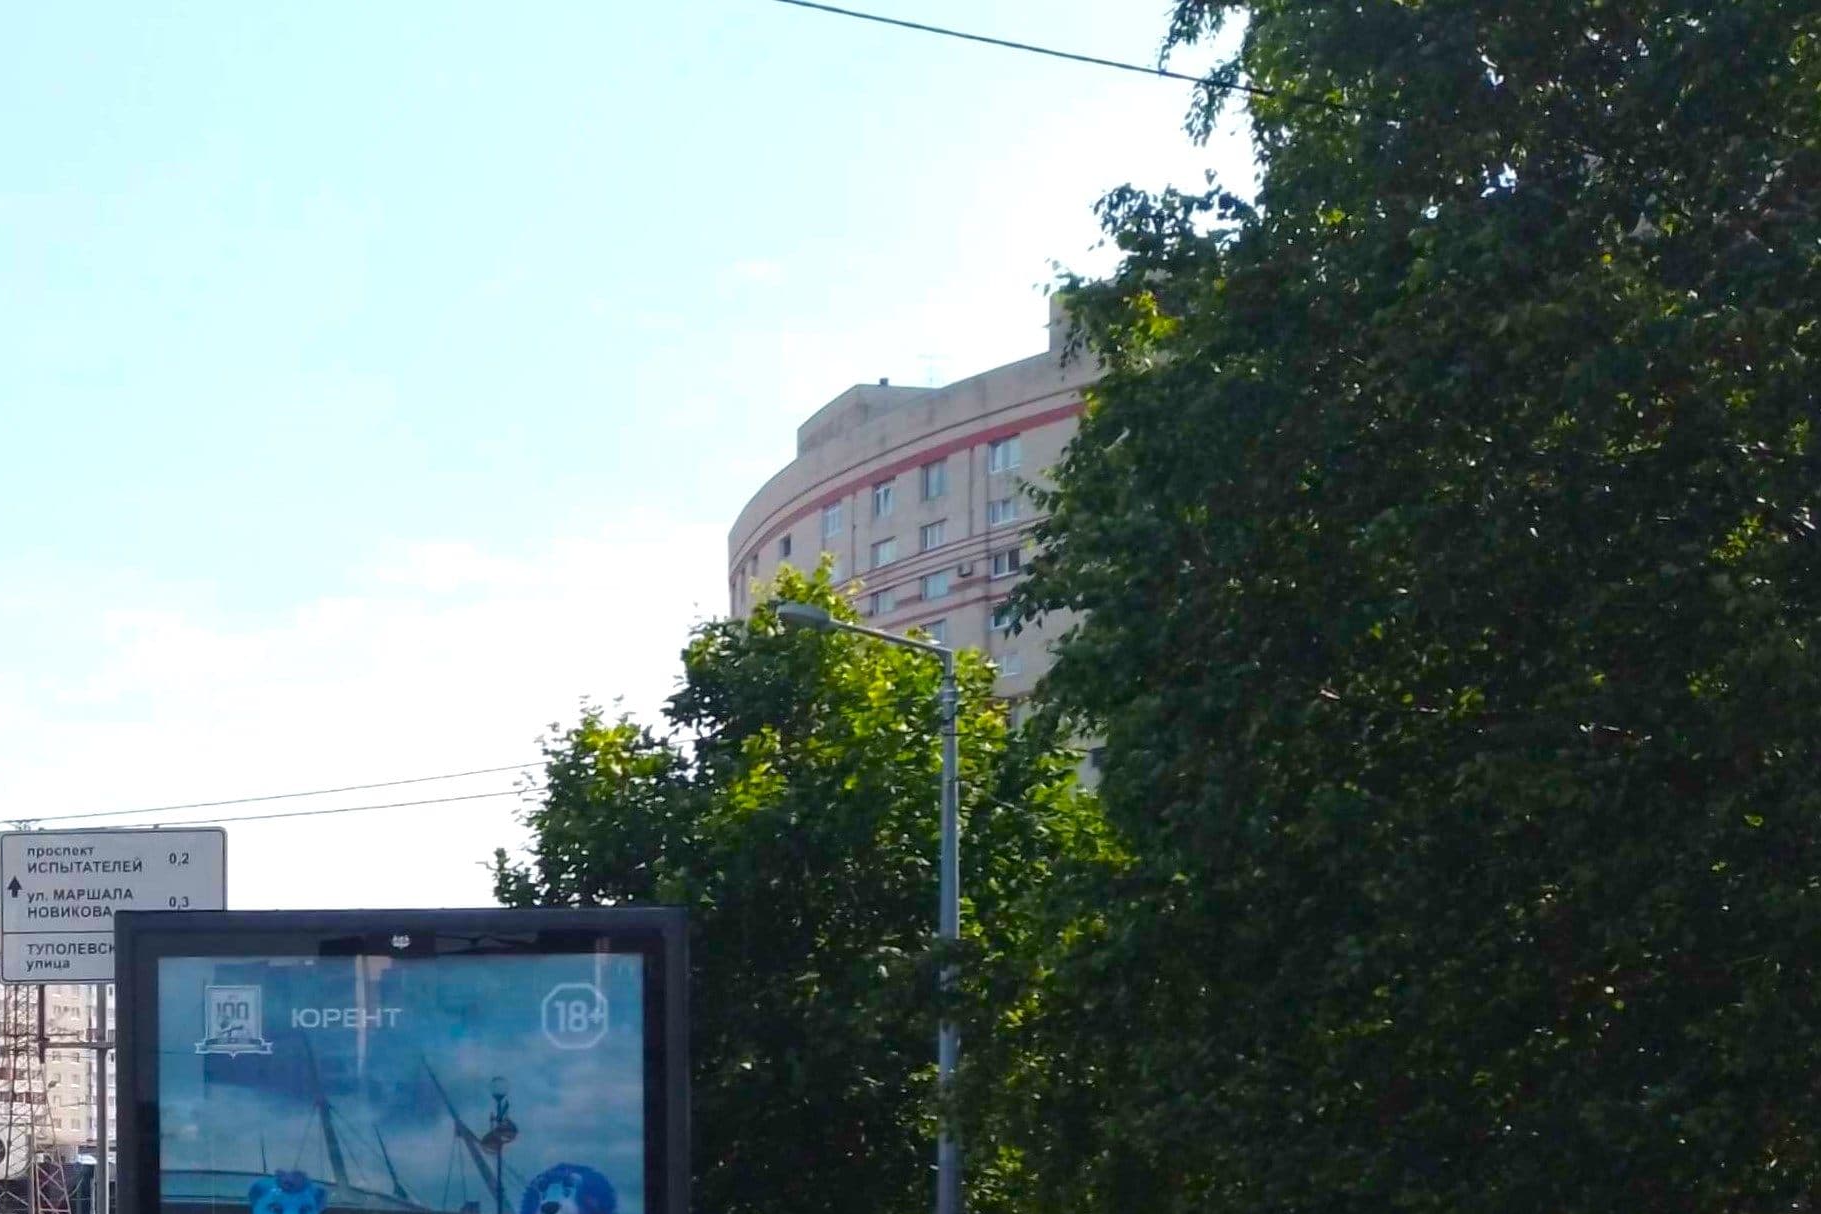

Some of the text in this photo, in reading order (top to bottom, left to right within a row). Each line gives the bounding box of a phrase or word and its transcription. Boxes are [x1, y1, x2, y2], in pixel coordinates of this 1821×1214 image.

[27, 847, 94, 859] проспект
[168, 852, 190, 867] 0,2
[27, 857, 142, 874] ИСПЫТАТЕЛЕЙ
[27, 888, 133, 903] ул. МАРШАЛА
[168, 896, 190, 910] 0,3
[27, 906, 113, 919] НОВИКОВА
[26, 959, 70, 972] улица
[291, 1008, 402, 1028] ЮРЕНТ
[554, 1000, 604, 1032] 18+
